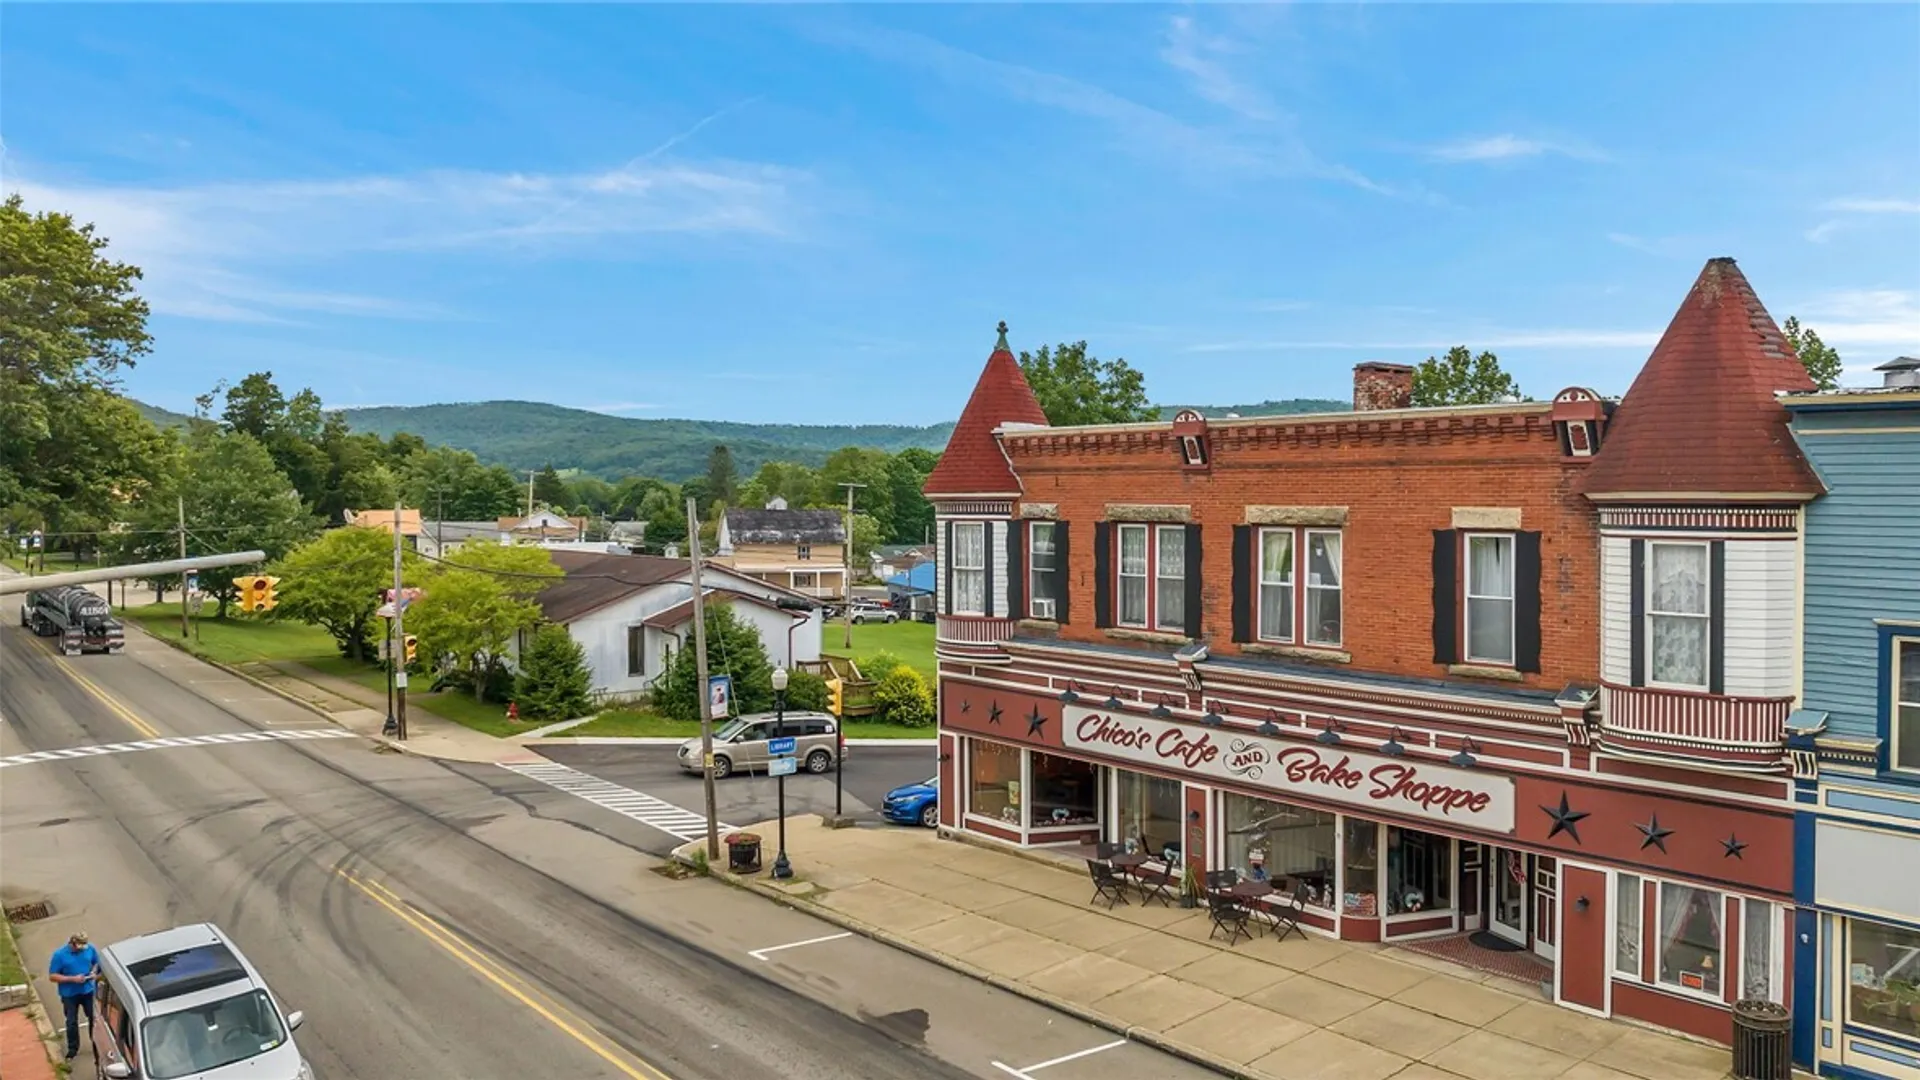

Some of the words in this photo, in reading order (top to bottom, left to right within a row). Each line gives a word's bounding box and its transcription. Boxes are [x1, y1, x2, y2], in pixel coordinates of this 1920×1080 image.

[771, 741, 793, 751] LIBRARY
[1076, 714, 1152, 750] Chico's
[1155, 728, 1219, 769] Cafe
[1232, 752, 1263, 767] AND
[1277, 747, 1364, 790] Bake
[1369, 764, 1491, 815] Shoppe
